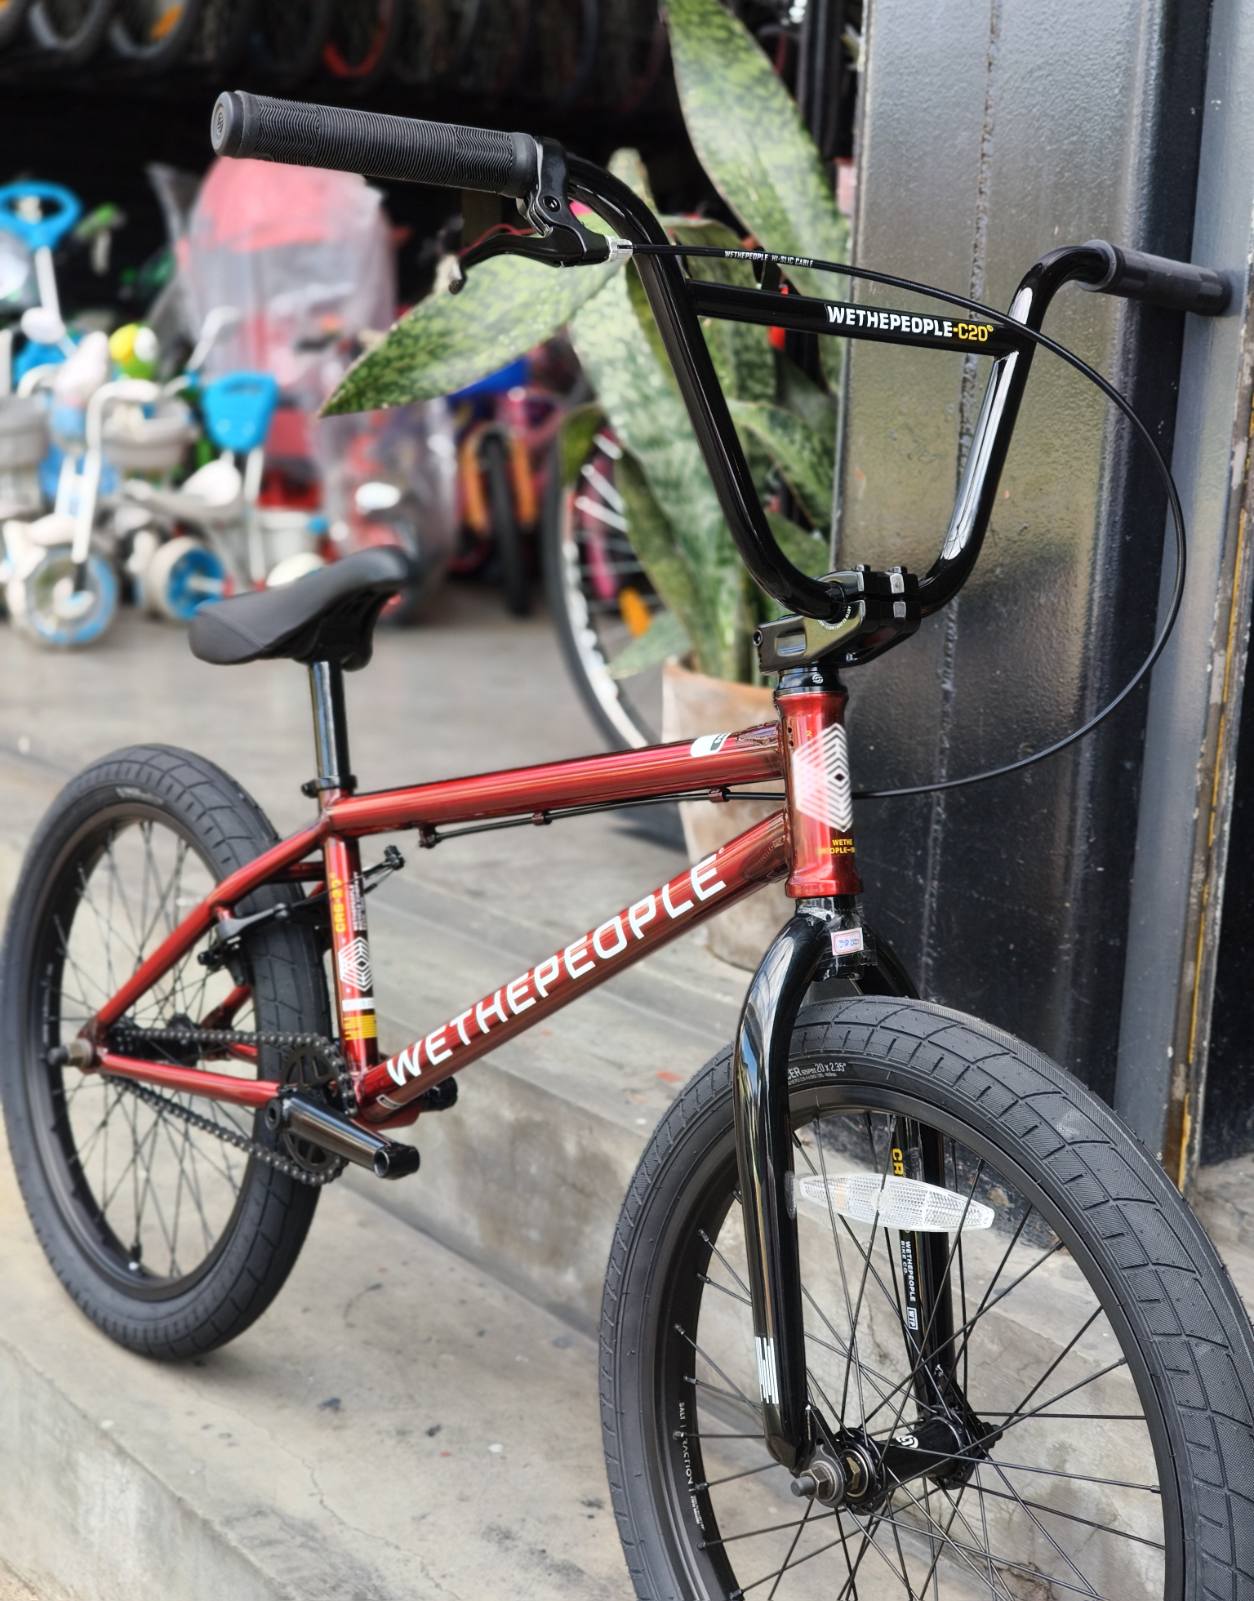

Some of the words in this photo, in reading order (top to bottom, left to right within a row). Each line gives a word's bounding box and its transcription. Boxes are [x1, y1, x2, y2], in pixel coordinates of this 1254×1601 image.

[386, 853, 727, 1087] WETHEPEOPLE
[905, 1240, 917, 1302] WETHEPEOPLE
[682, 1436, 694, 1485] RACTION
